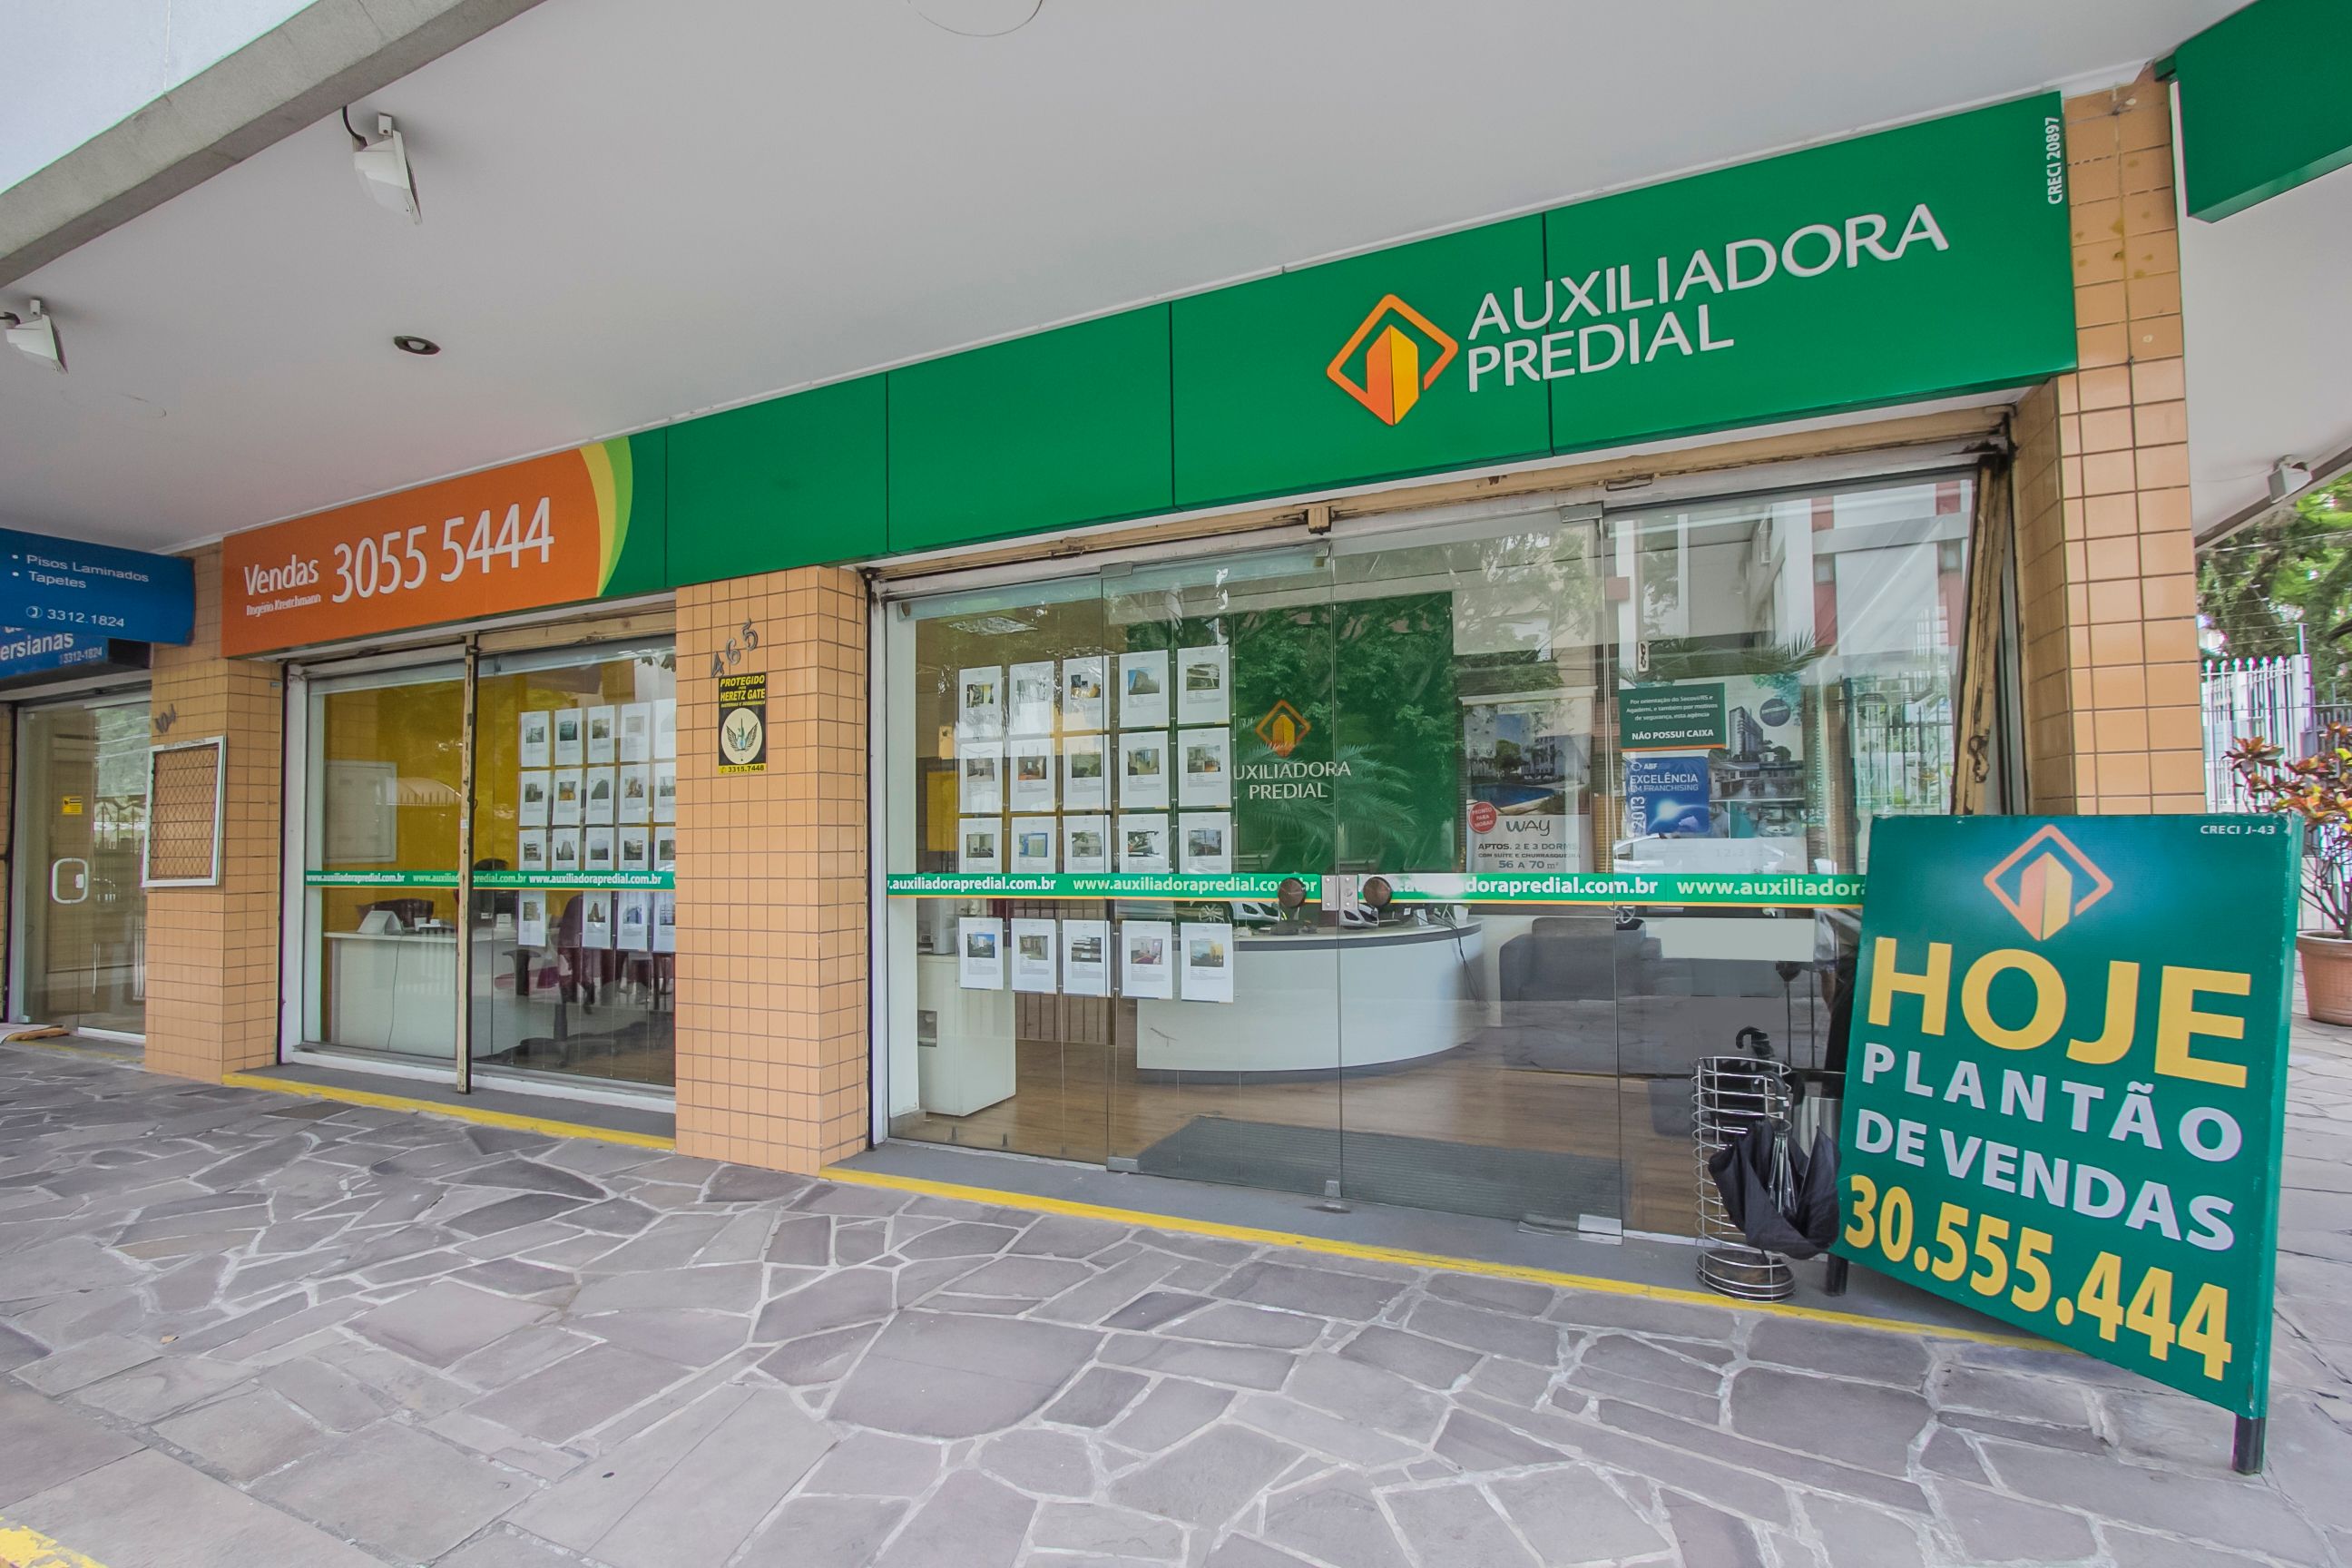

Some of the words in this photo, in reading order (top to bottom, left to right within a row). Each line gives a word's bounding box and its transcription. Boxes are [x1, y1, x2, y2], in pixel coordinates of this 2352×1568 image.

[2044, 117, 2061, 160] 20897
[2047, 162, 2063, 205] CRECI
[1467, 203, 1949, 340] AUXILIADORA
[1469, 304, 1734, 392] PREDIAL
[332, 525, 427, 603] 3055
[441, 496, 554, 583] 5444
[26, 554, 68, 570] Pisos
[73, 562, 150, 583] Laminados
[29, 571, 86, 589] Tapetes
[244, 554, 319, 596] Vendas
[0, 632, 74, 661] ersianas
[720, 675, 765, 687] PROTEGIDO
[720, 690, 746, 701] HERETZ
[748, 689, 765, 699] GATE
[1632, 730, 1651, 740] NÃO
[1652, 730, 1685, 739] POSSUI
[1686, 729, 1714, 737] CAIXA
[1233, 760, 1351, 779] UXILIADORA
[1630, 771, 1699, 784] EXCELÊNCIA
[1250, 783, 1328, 799] PREDIAL
[1631, 796, 1645, 829] 2013
[2200, 825, 2239, 835] CRECI
[2244, 825, 2276, 835] J-43
[1498, 860, 1514, 868] 56
[1529, 860, 1544, 868] 70
[529, 873, 662, 887] www.auxiliadorapredial.com.br
[1867, 936, 2251, 1089] HOJE
[1861, 1042, 2243, 1163] PLANTÃO
[1854, 1109, 1927, 1168] DE
[1939, 1129, 2236, 1251] VENDAS
[1844, 1173, 2232, 1382] 30.555.444
